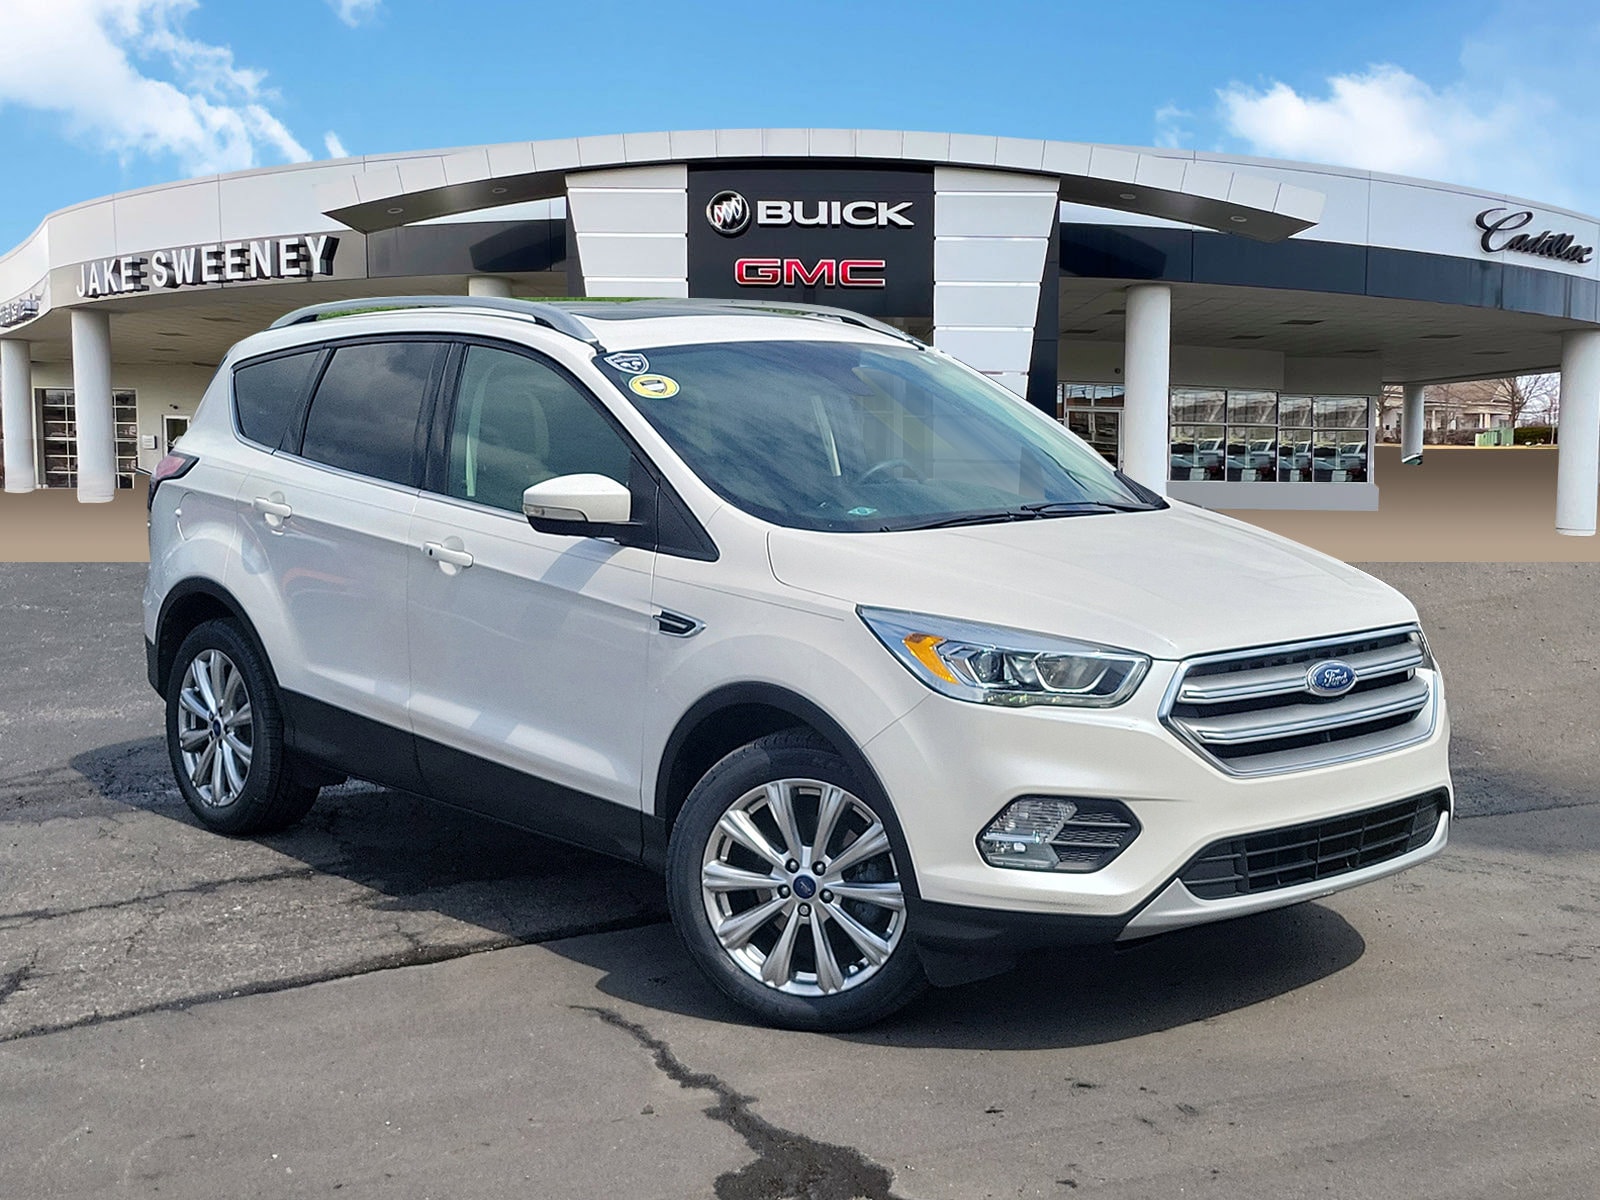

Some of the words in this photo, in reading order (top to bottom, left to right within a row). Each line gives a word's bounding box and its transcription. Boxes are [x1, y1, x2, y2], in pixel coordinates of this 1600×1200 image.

[757, 200, 915, 227] BUICK
[1475, 207, 1593, 264] Cadillac
[76, 256, 142, 298] JAKE
[151, 235, 336, 287] SWEENEY
[734, 257, 886, 287] GMC
[1323, 668, 1348, 687] Ford
